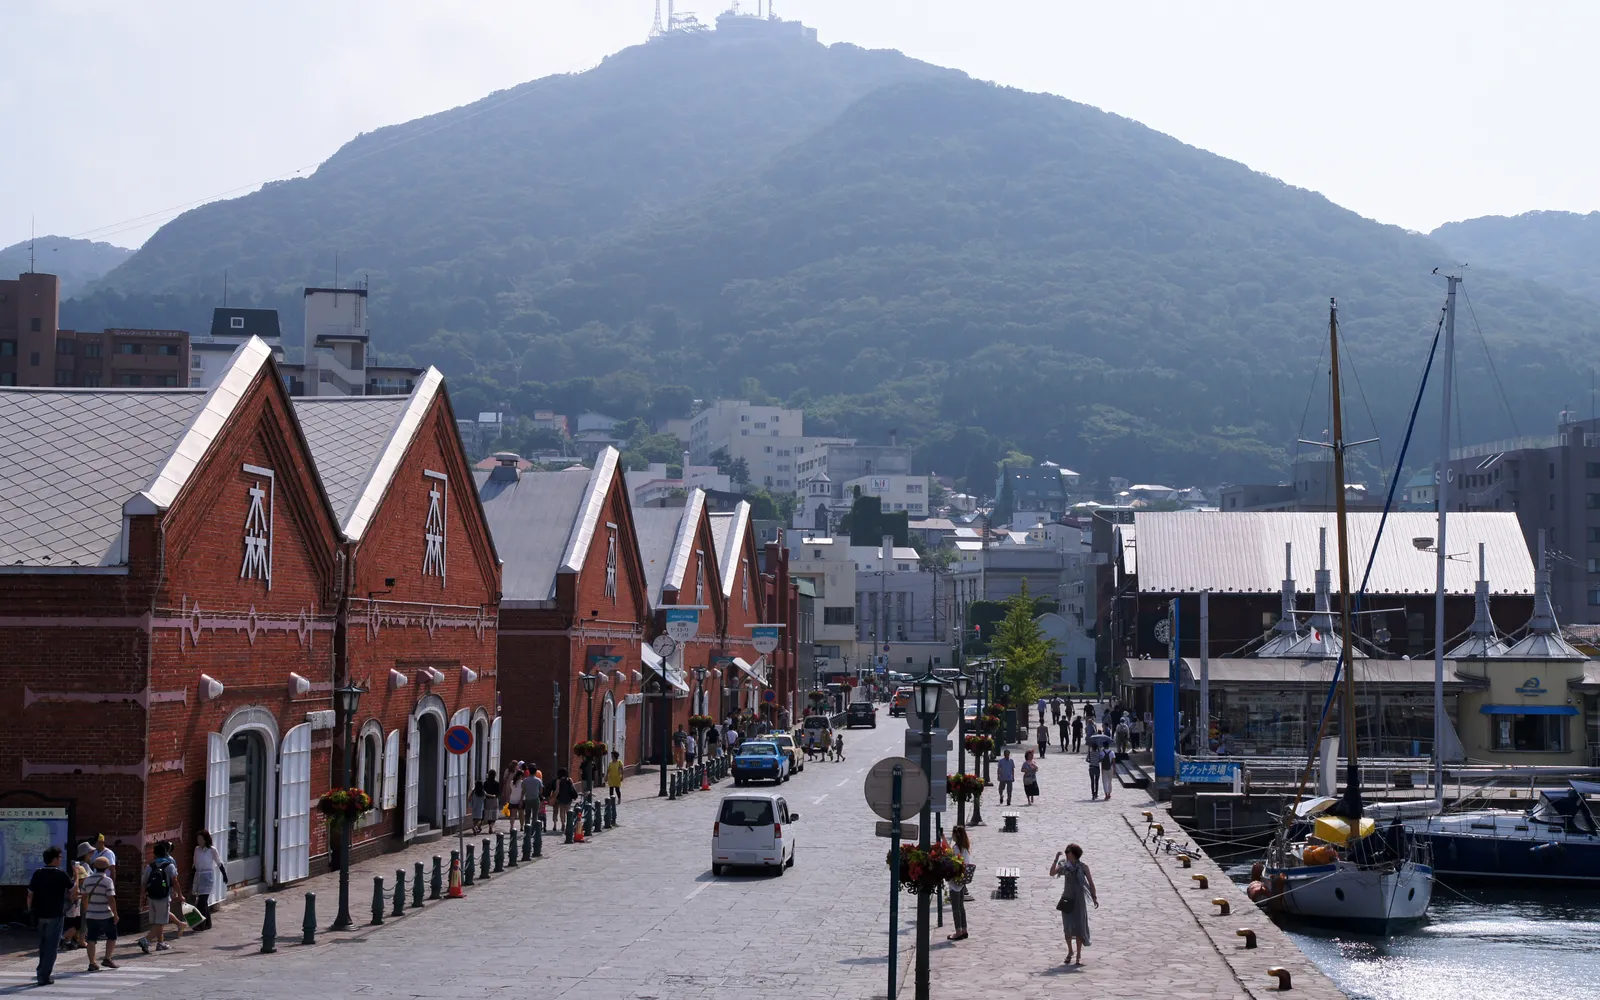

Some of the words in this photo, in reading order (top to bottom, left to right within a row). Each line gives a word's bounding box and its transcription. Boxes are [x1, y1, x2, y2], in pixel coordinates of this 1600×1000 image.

[1181, 764, 1227, 775] チケット売場
